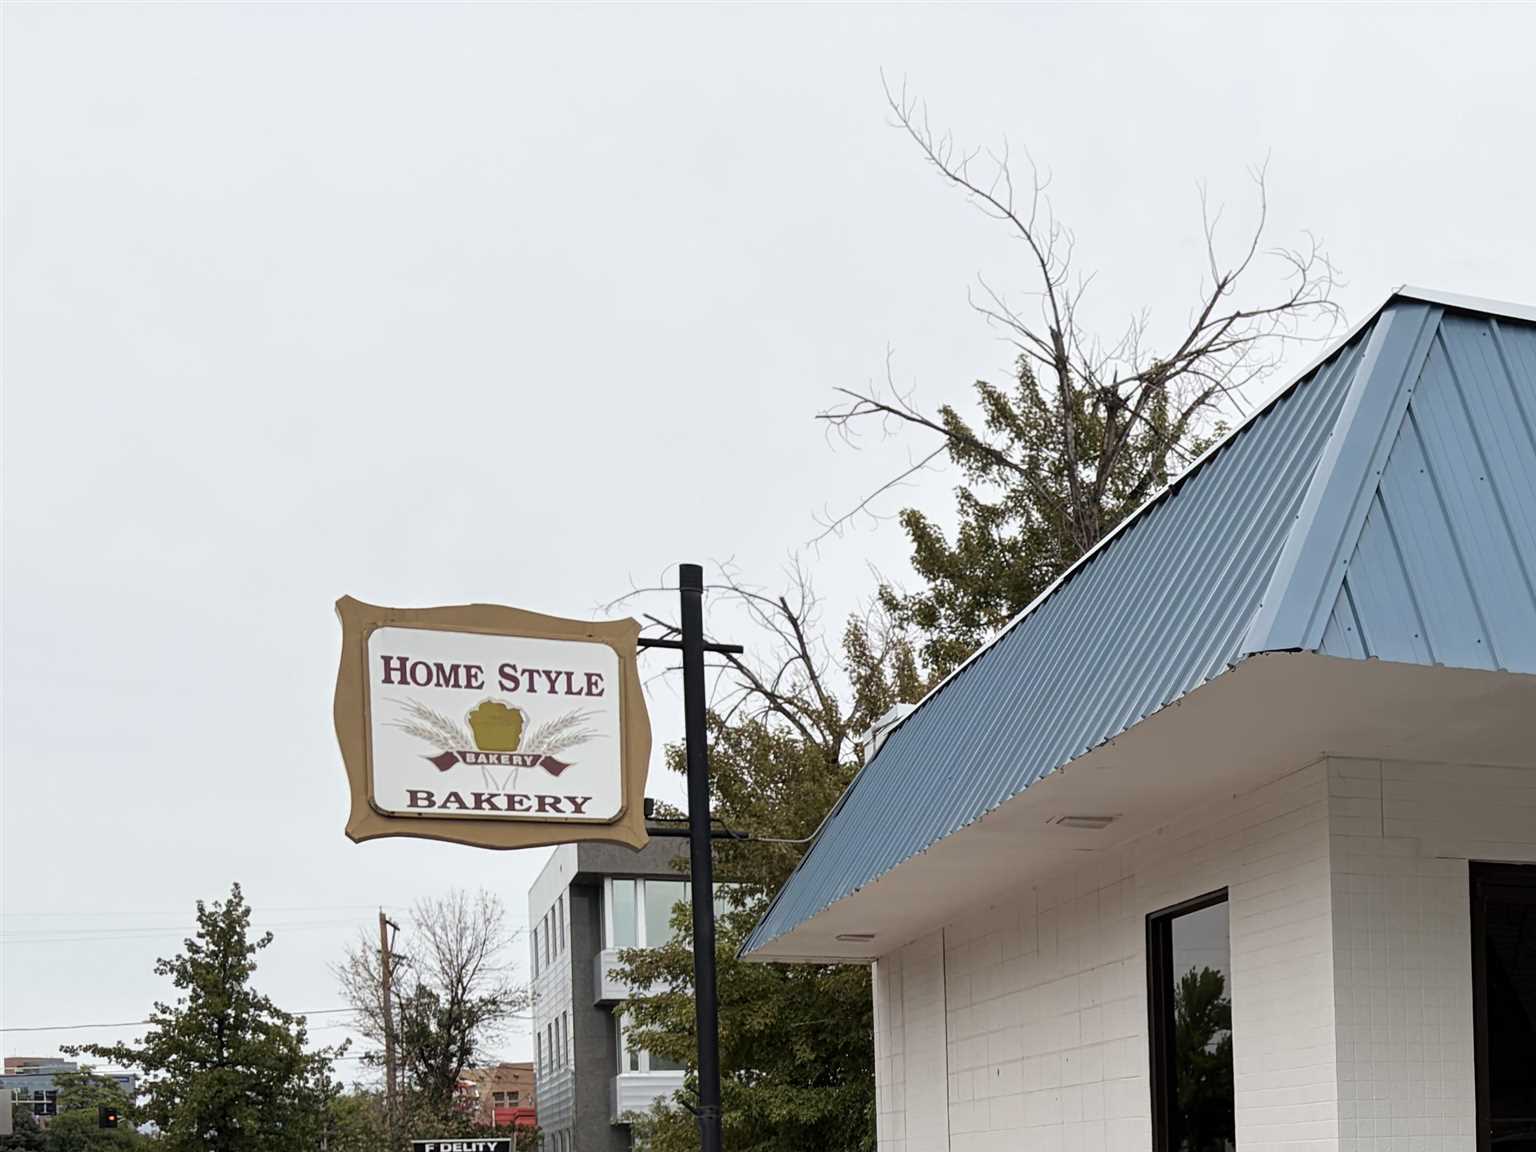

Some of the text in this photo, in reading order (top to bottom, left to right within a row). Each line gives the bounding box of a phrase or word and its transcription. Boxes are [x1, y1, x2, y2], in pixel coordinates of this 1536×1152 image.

[380, 655, 605, 698] HOME STYLE
[466, 753, 534, 766] BAKERY
[406, 789, 592, 814] BAKERY
